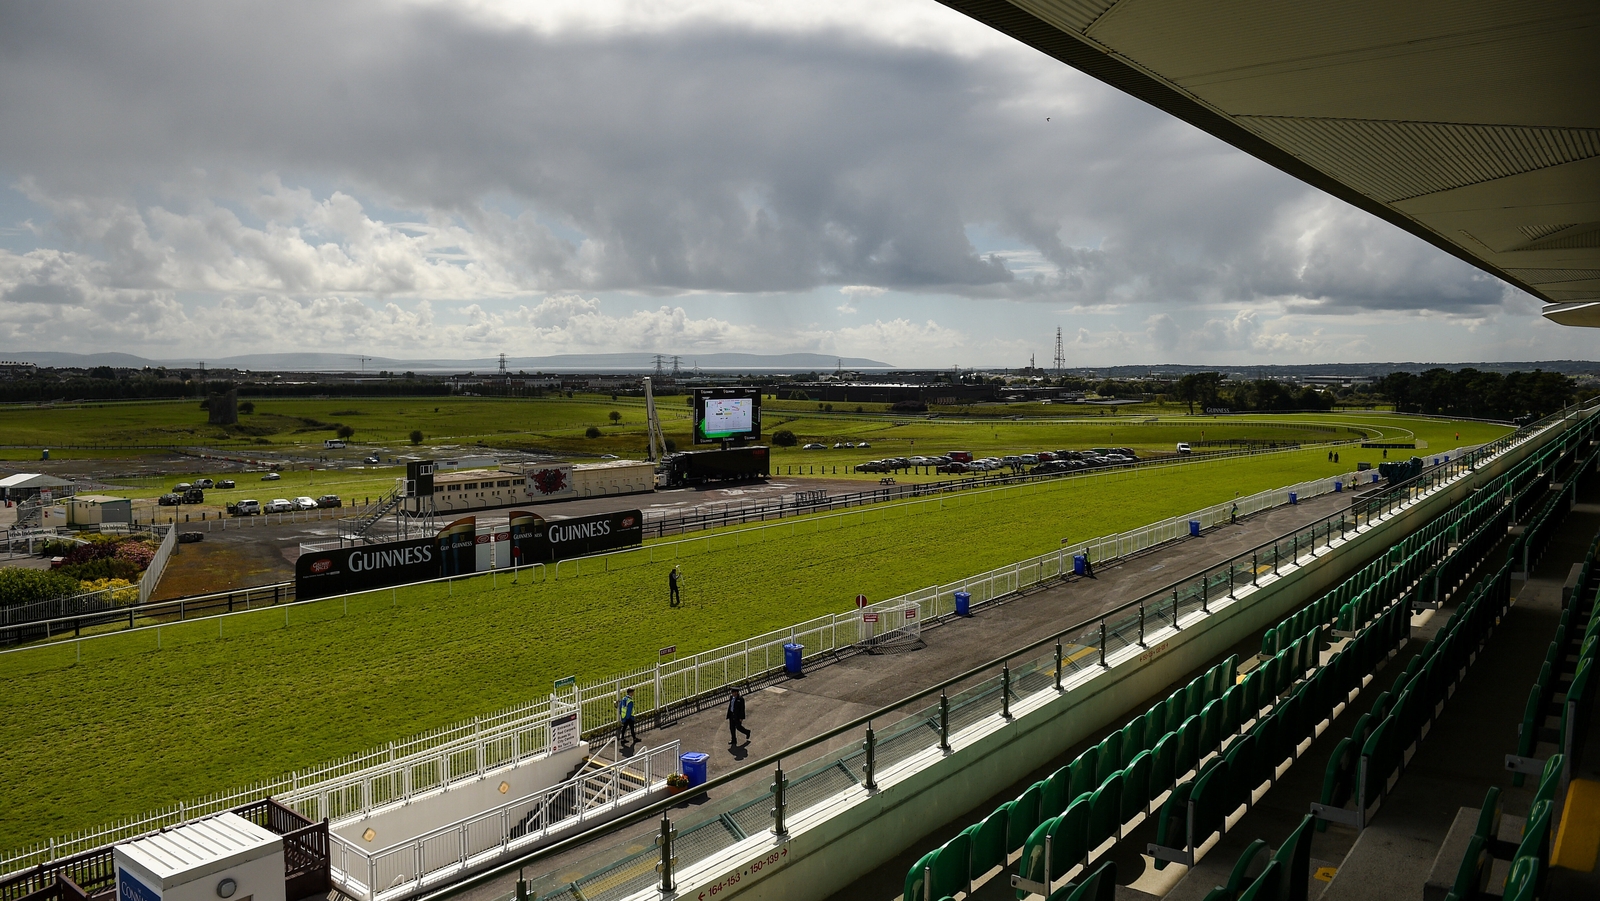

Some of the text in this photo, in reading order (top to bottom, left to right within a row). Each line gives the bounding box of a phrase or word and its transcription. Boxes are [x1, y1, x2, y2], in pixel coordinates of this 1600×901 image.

[513, 532, 533, 540] GUINNESS
[549, 519, 611, 543] GUINNESS
[451, 541, 473, 549] GUINNESS
[348, 544, 432, 573] GUINNESS
[708, 852, 779, 897] 164-153 150-139
